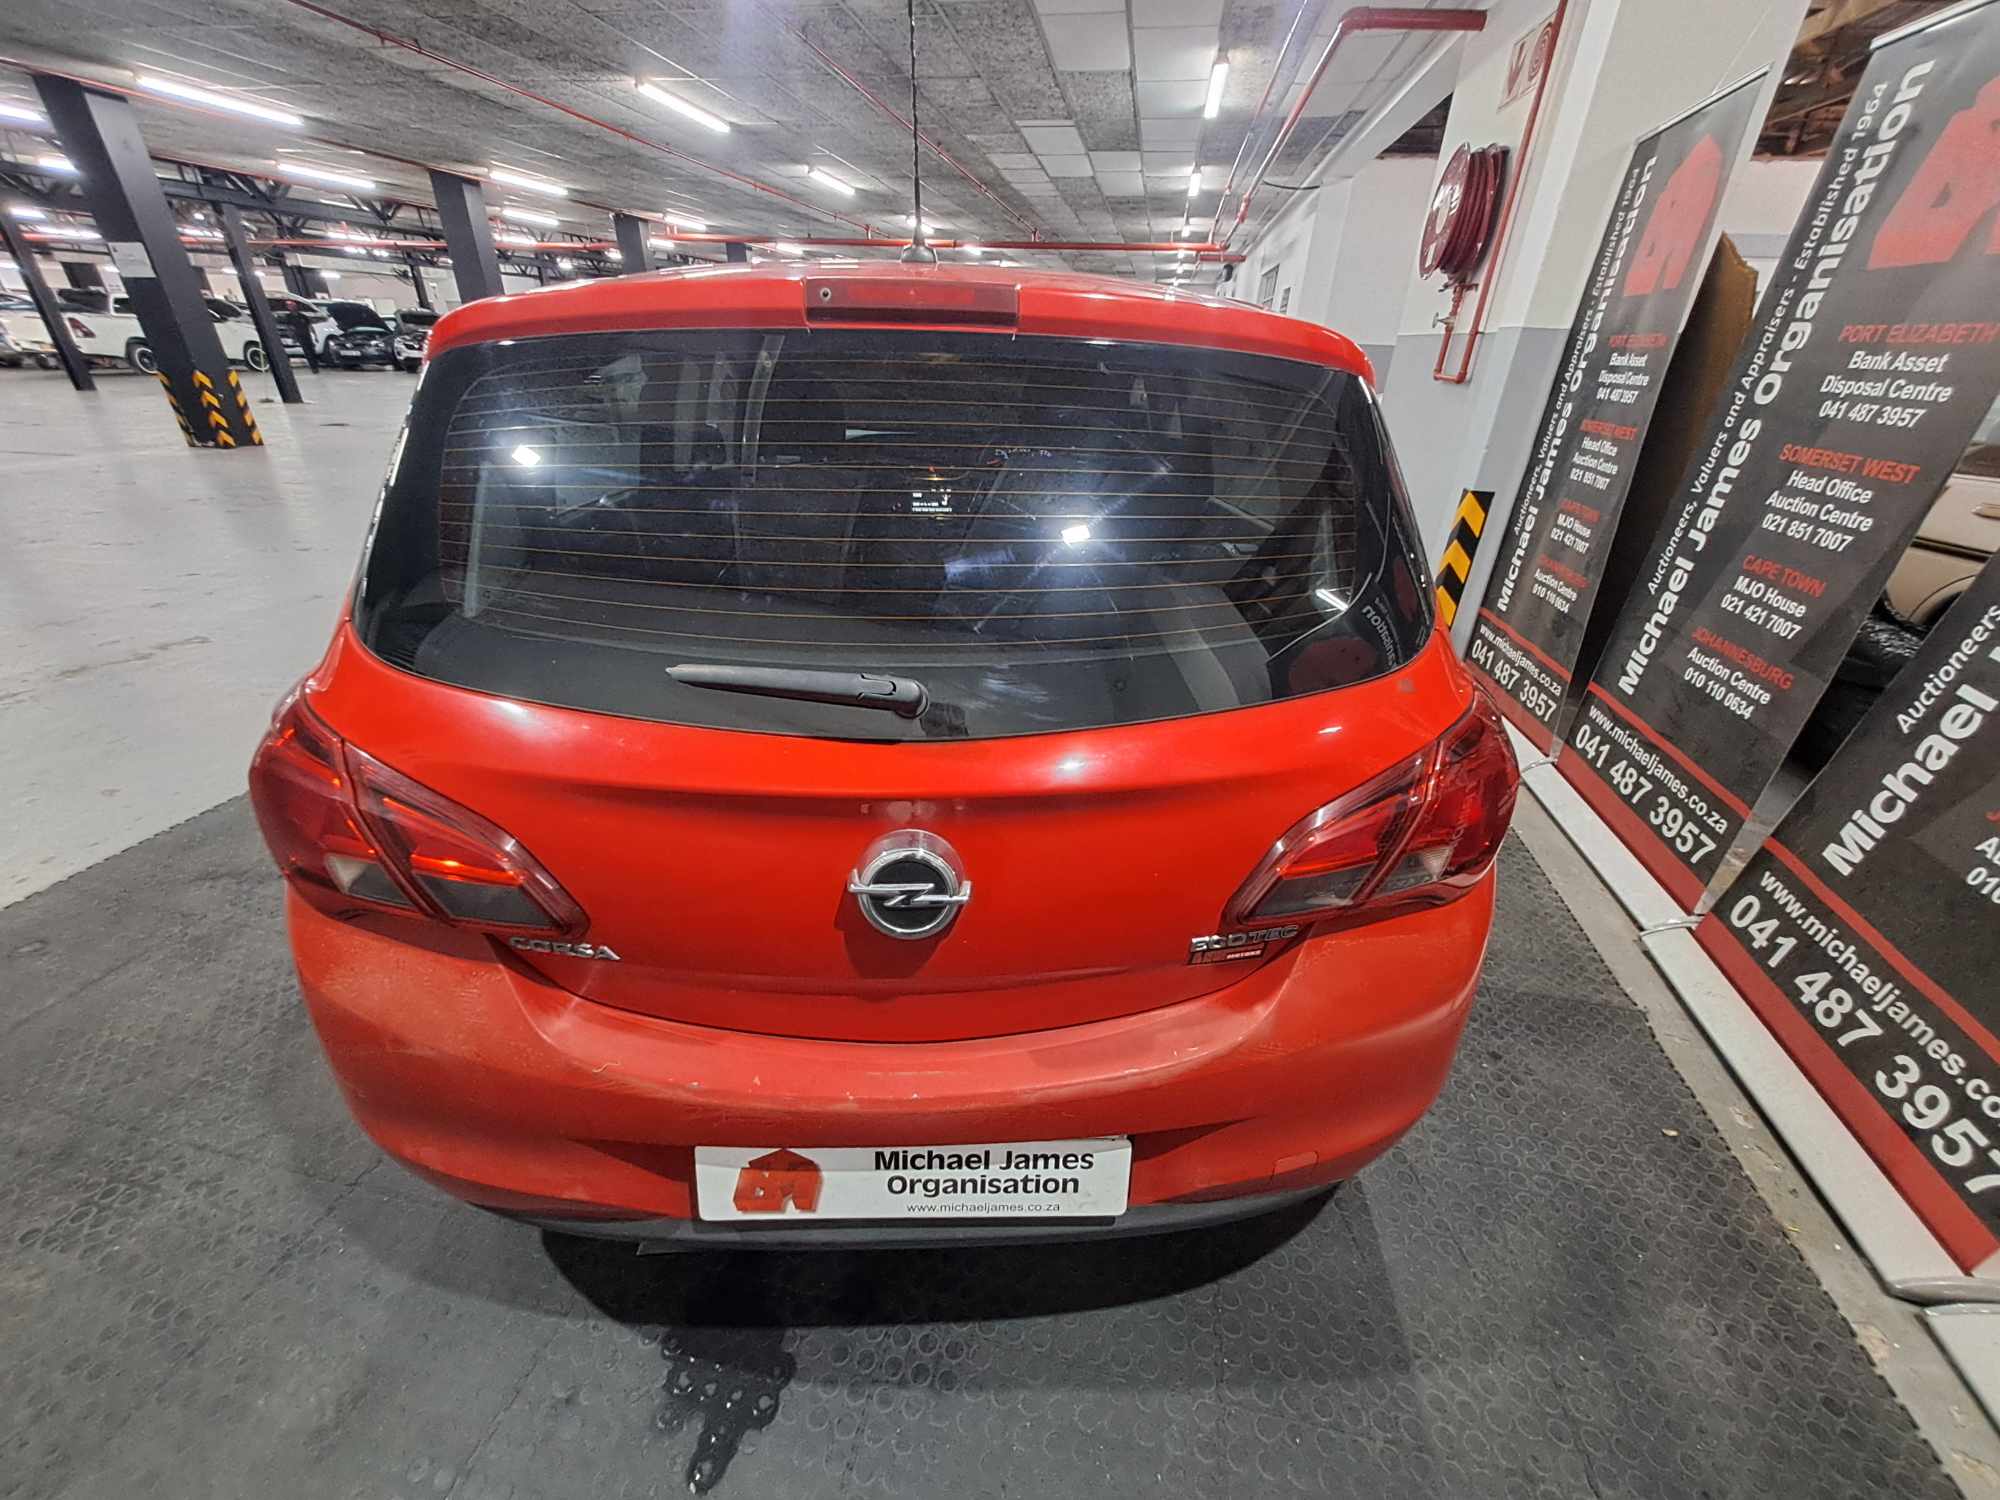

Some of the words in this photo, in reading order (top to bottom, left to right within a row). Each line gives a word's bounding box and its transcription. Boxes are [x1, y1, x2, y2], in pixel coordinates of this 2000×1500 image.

[1647, 501, 1698, 595] Auctioneers,
[1691, 431, 1728, 494] Valuers
[1724, 391, 1747, 428] and
[1741, 288, 1795, 390] Appraisers
[1794, 148, 1860, 270] Established
[1852, 82, 1889, 141] 1964
[1839, 324, 1888, 343] PORT
[1886, 323, 2000, 343] ELIZABETH
[1618, 556, 1696, 695] Michael
[1688, 418, 1762, 551] James
[1754, 59, 1936, 405] Organisation
[1847, 350, 1891, 370] Bank
[1892, 352, 1950, 373] Asset
[1497, 505, 1539, 612] Michael
[1536, 401, 1573, 501] James
[1569, 155, 1658, 393] Organisation
[1556, 384, 1568, 410] and
[1819, 375, 1890, 397] Disposal
[1889, 378, 1953, 402] Centre
[1818, 400, 1847, 419] 041
[1848, 402, 1879, 423] 487
[1876, 406, 1927, 429] 3957
[1778, 443, 1864, 473] SOMERSET
[1862, 457, 1921, 485] WEST
[1786, 469, 1828, 494] Head
[1826, 477, 1873, 504] Office
[1761, 513, 1787, 533] 021
[1787, 520, 1814, 542] 851
[1812, 525, 1854, 552] 7007
[1765, 490, 1819, 517] Auction
[1818, 502, 1874, 532] Centre
[1734, 575, 1765, 602] MJO
[1762, 587, 1808, 618] House
[1743, 554, 1781, 581] CAPE
[1781, 567, 1827, 598] TOWN
[1720, 593, 1744, 615] 021
[1744, 604, 1769, 626] 421
[1765, 612, 1803, 640] 7007
[1472, 640, 1495, 670] 041
[1494, 660, 1520, 690] 487
[1520, 680, 1557, 722] 3957
[1480, 624, 1562, 696] www.michaeljames.co.za
[1687, 647, 1731, 680] Auction
[1730, 671, 1771, 705] Centre
[1684, 667, 1706, 689] 010
[1707, 677, 1726, 701] 110
[1724, 692, 1755, 720] 0634
[1588, 705, 1728, 835] www.michaeljames.co.za
[1822, 684, 1999, 877] Michael
[1575, 724, 1611, 769] 041
[1609, 759, 1653, 804] 487
[1649, 796, 1717, 864] 3957
[511, 937, 621, 960] CORSA
[1730, 895, 1798, 968] 041
[1794, 971, 1883, 1047] 487
[1760, 870, 2000, 1122] www.michaeljames.co
[874, 1150, 990, 1171] Michael
[999, 1150, 1095, 1170] James
[887, 1174, 1079, 1198] Organisation
[907, 1203, 1060, 1214] www.michaeljames.co.za
